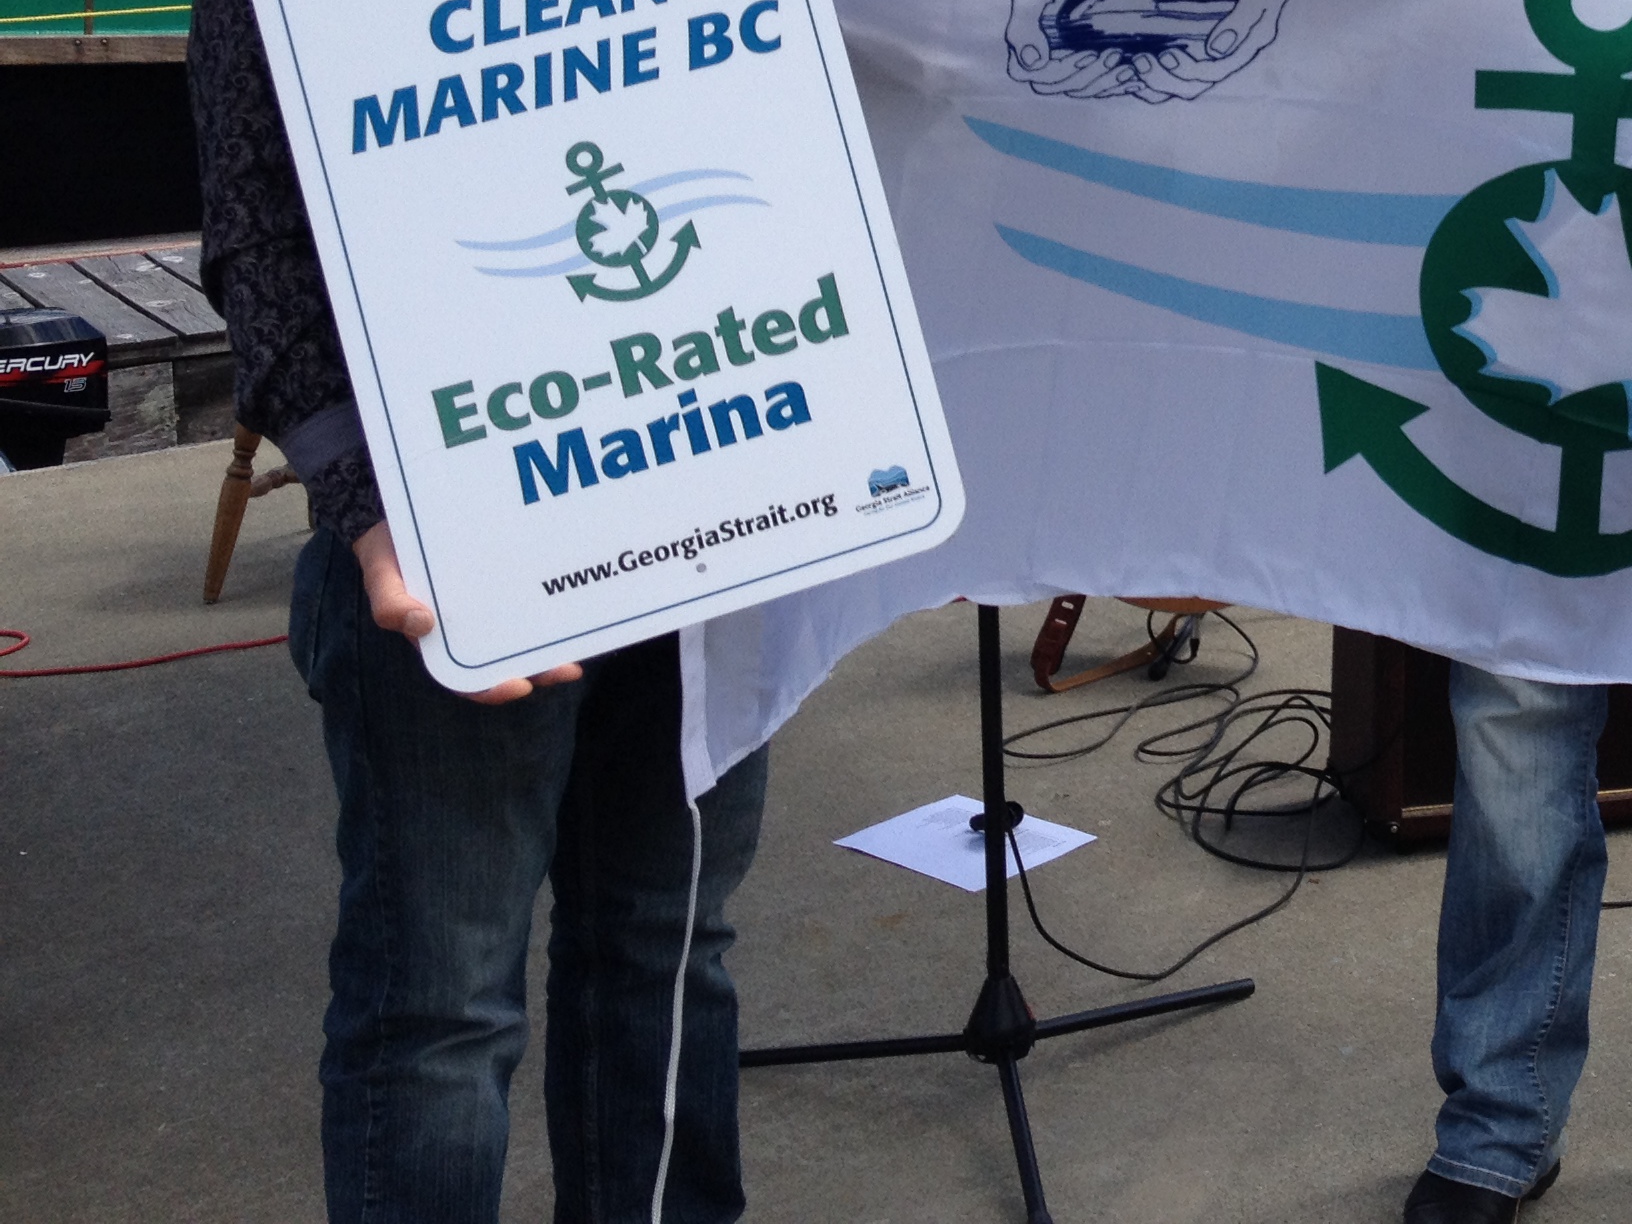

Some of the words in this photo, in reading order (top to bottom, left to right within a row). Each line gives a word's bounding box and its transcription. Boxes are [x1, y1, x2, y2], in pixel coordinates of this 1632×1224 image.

[352, 26, 660, 155] MARINE
[63, 377, 88, 393] 15
[431, 272, 850, 449] Eco-Rated
[512, 380, 813, 506] Marina
[542, 492, 838, 596] www.GeorgiaStrait.org
